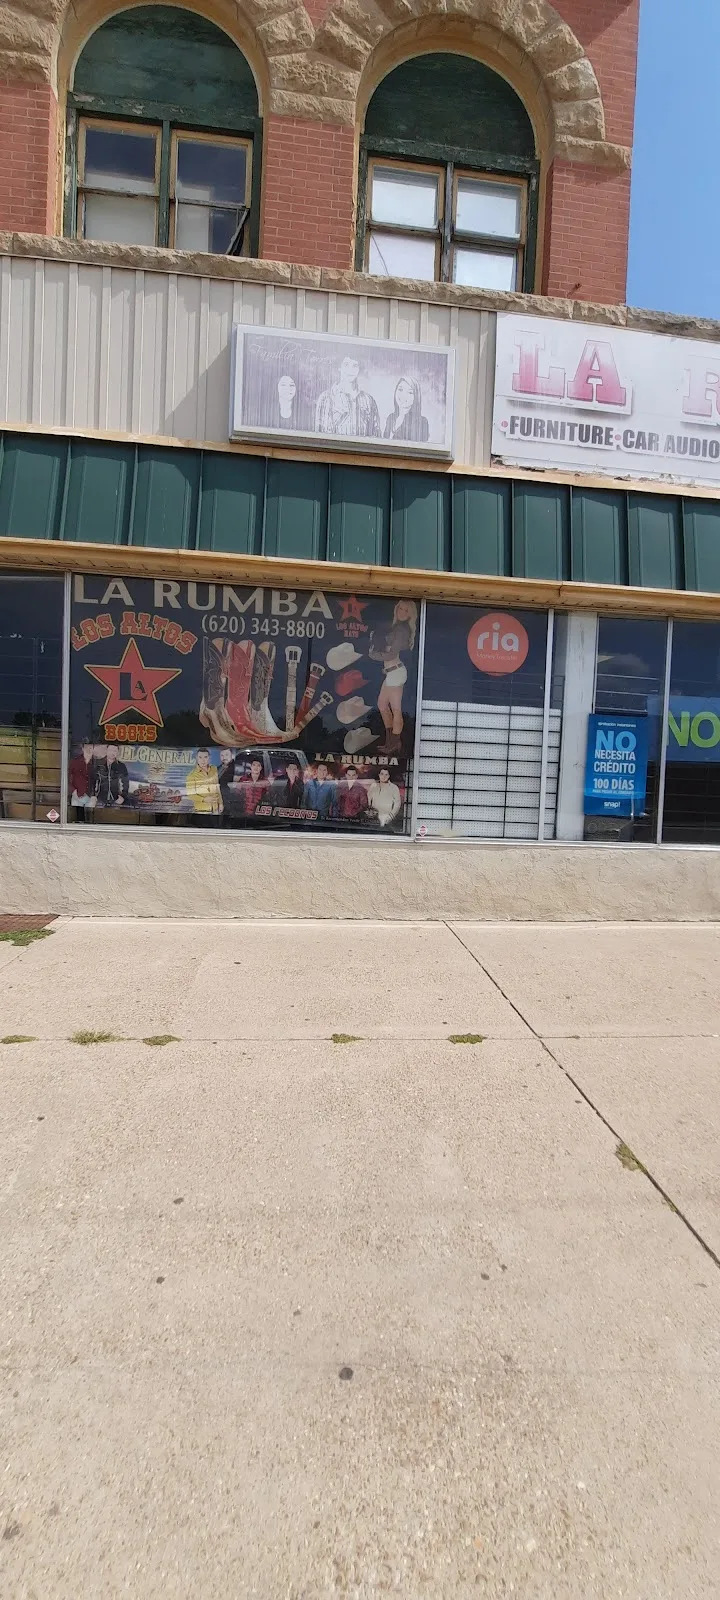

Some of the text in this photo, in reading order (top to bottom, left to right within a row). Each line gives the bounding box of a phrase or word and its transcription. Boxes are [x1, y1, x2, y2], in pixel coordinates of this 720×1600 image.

[512, 330, 627, 407] LA
[509, 415, 720, 459] FURNITURE CAR AUDIO
[74, 575, 334, 620] LA RUMBA
[71, 611, 198, 655] LOS ALTOS
[201, 614, 325, 639] (620) 343-8800
[476, 621, 519, 652] ria
[119, 672, 147, 701] LA
[104, 724, 158, 742] BOOTS
[596, 729, 637, 752] NO
[667, 711, 720, 748] NO
[120, 745, 197, 765] EL GENERAL
[314, 752, 335, 763] LA
[341, 754, 399, 766] RUMBA
[593, 760, 636, 774] CRÉDITO
[594, 750, 636, 761] NECESITA
[593, 776, 635, 791] 100 DÍAS
